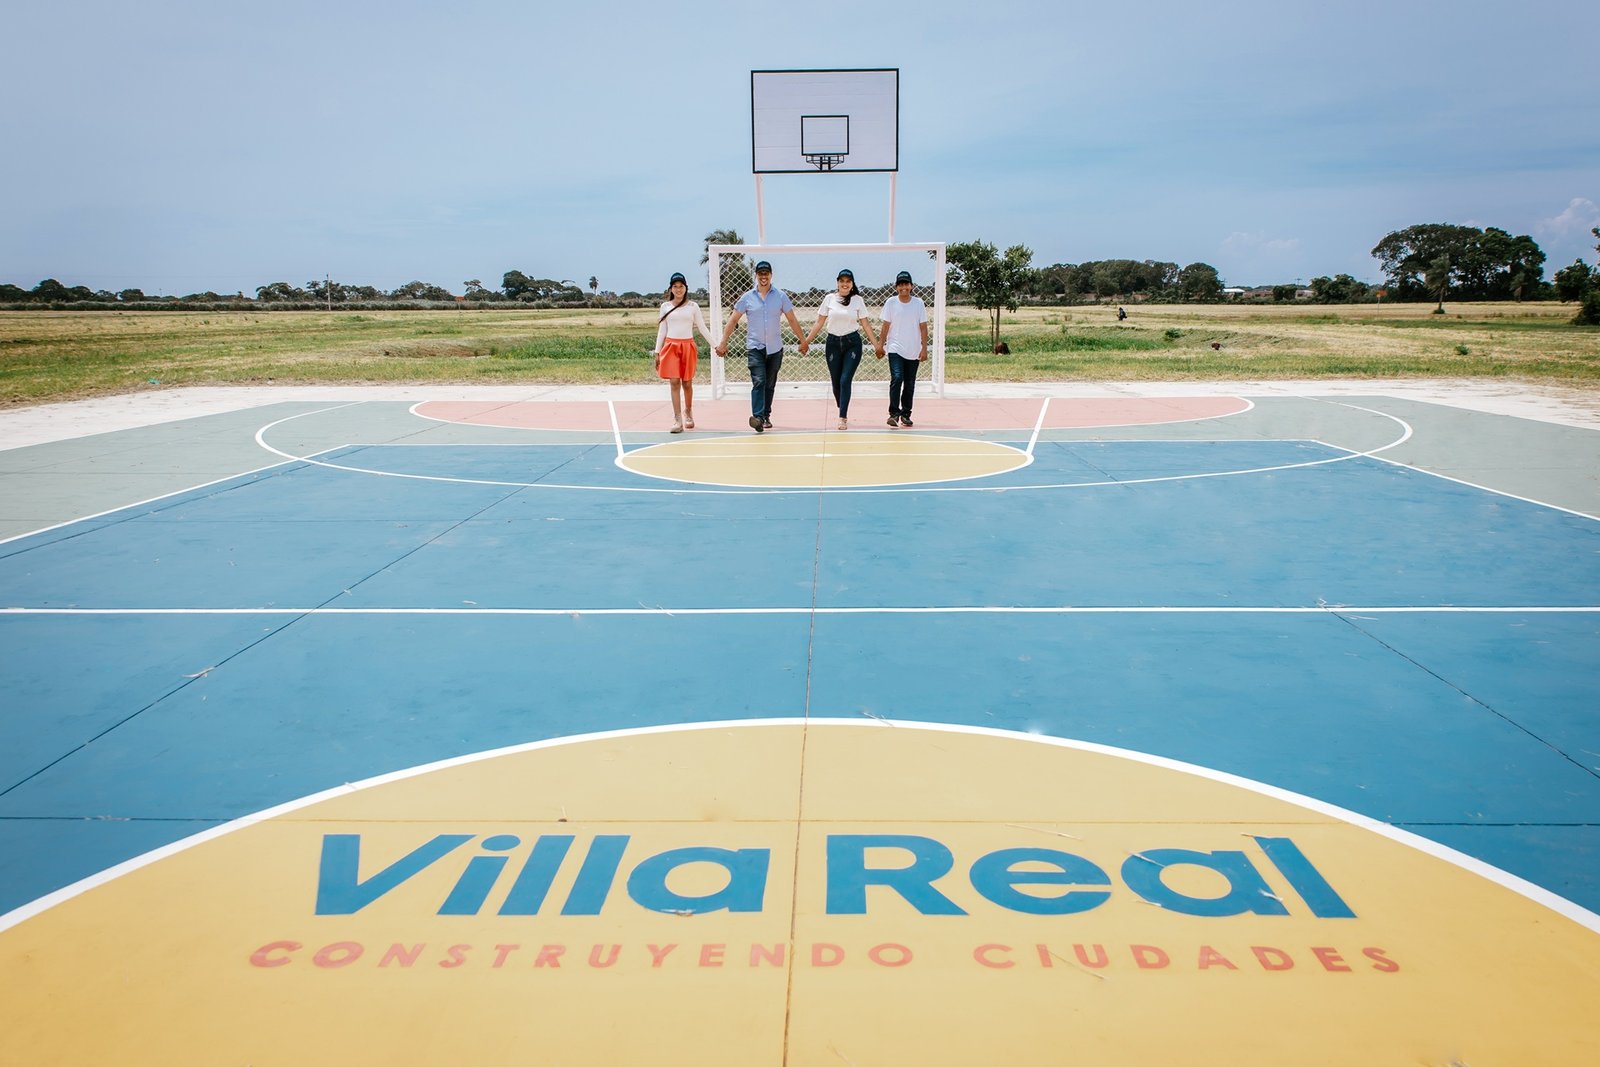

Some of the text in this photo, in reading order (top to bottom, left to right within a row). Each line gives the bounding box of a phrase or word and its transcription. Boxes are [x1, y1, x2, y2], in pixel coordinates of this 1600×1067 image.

[314, 834, 1358, 918] Villa Real
[249, 940, 1400, 974] CONSTRUYENDO CIUDADES
